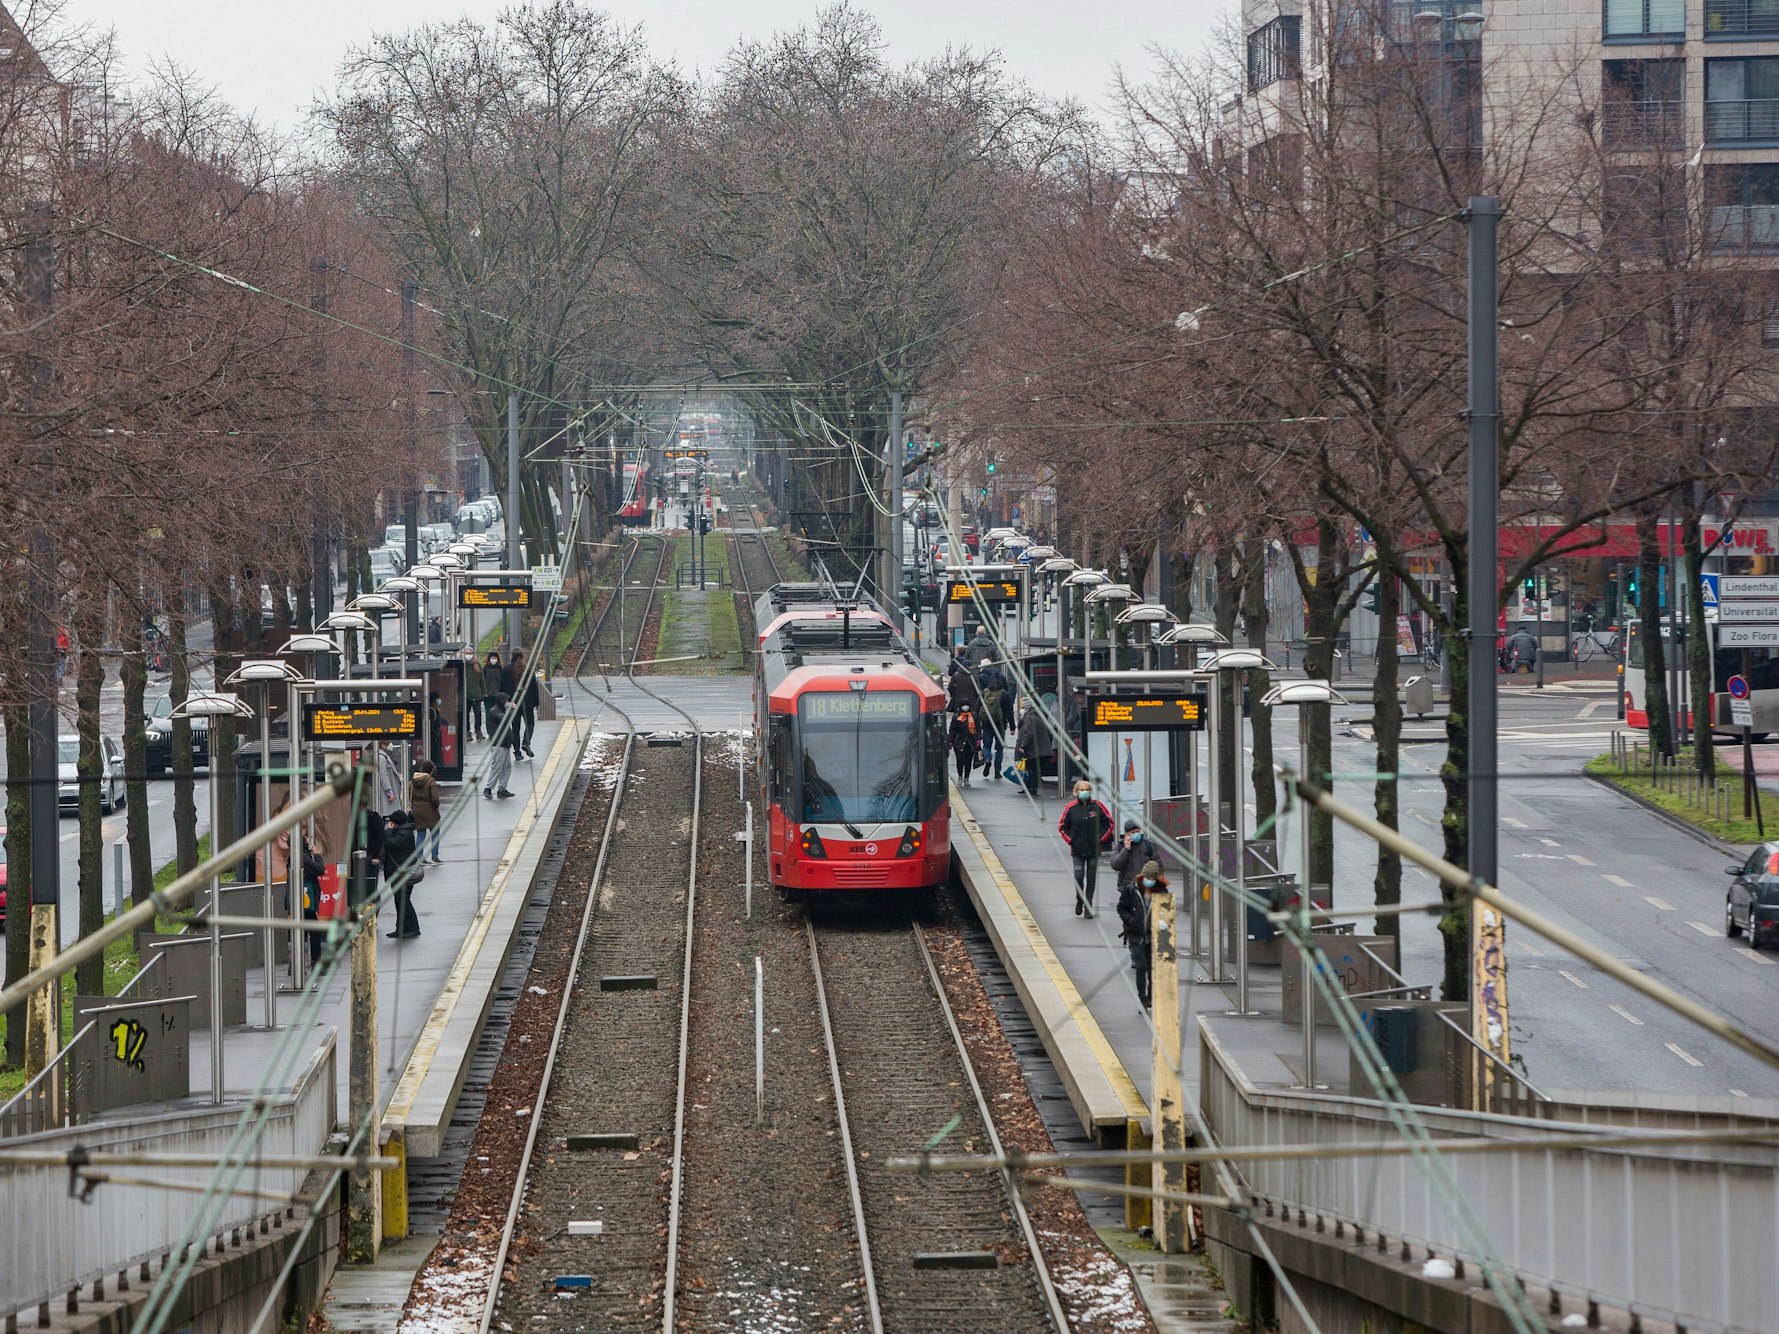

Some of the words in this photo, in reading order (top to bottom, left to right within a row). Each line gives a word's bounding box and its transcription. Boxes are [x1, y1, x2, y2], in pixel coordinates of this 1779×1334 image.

[1725, 582, 1778, 593] Lindenthal
[1723, 606, 1778, 617] Universität
[1730, 632, 1749, 641] Zoo
[1752, 631, 1778, 641] Flora
[811, 698, 826, 716] 18
[830, 698, 907, 715] Klettenberg
